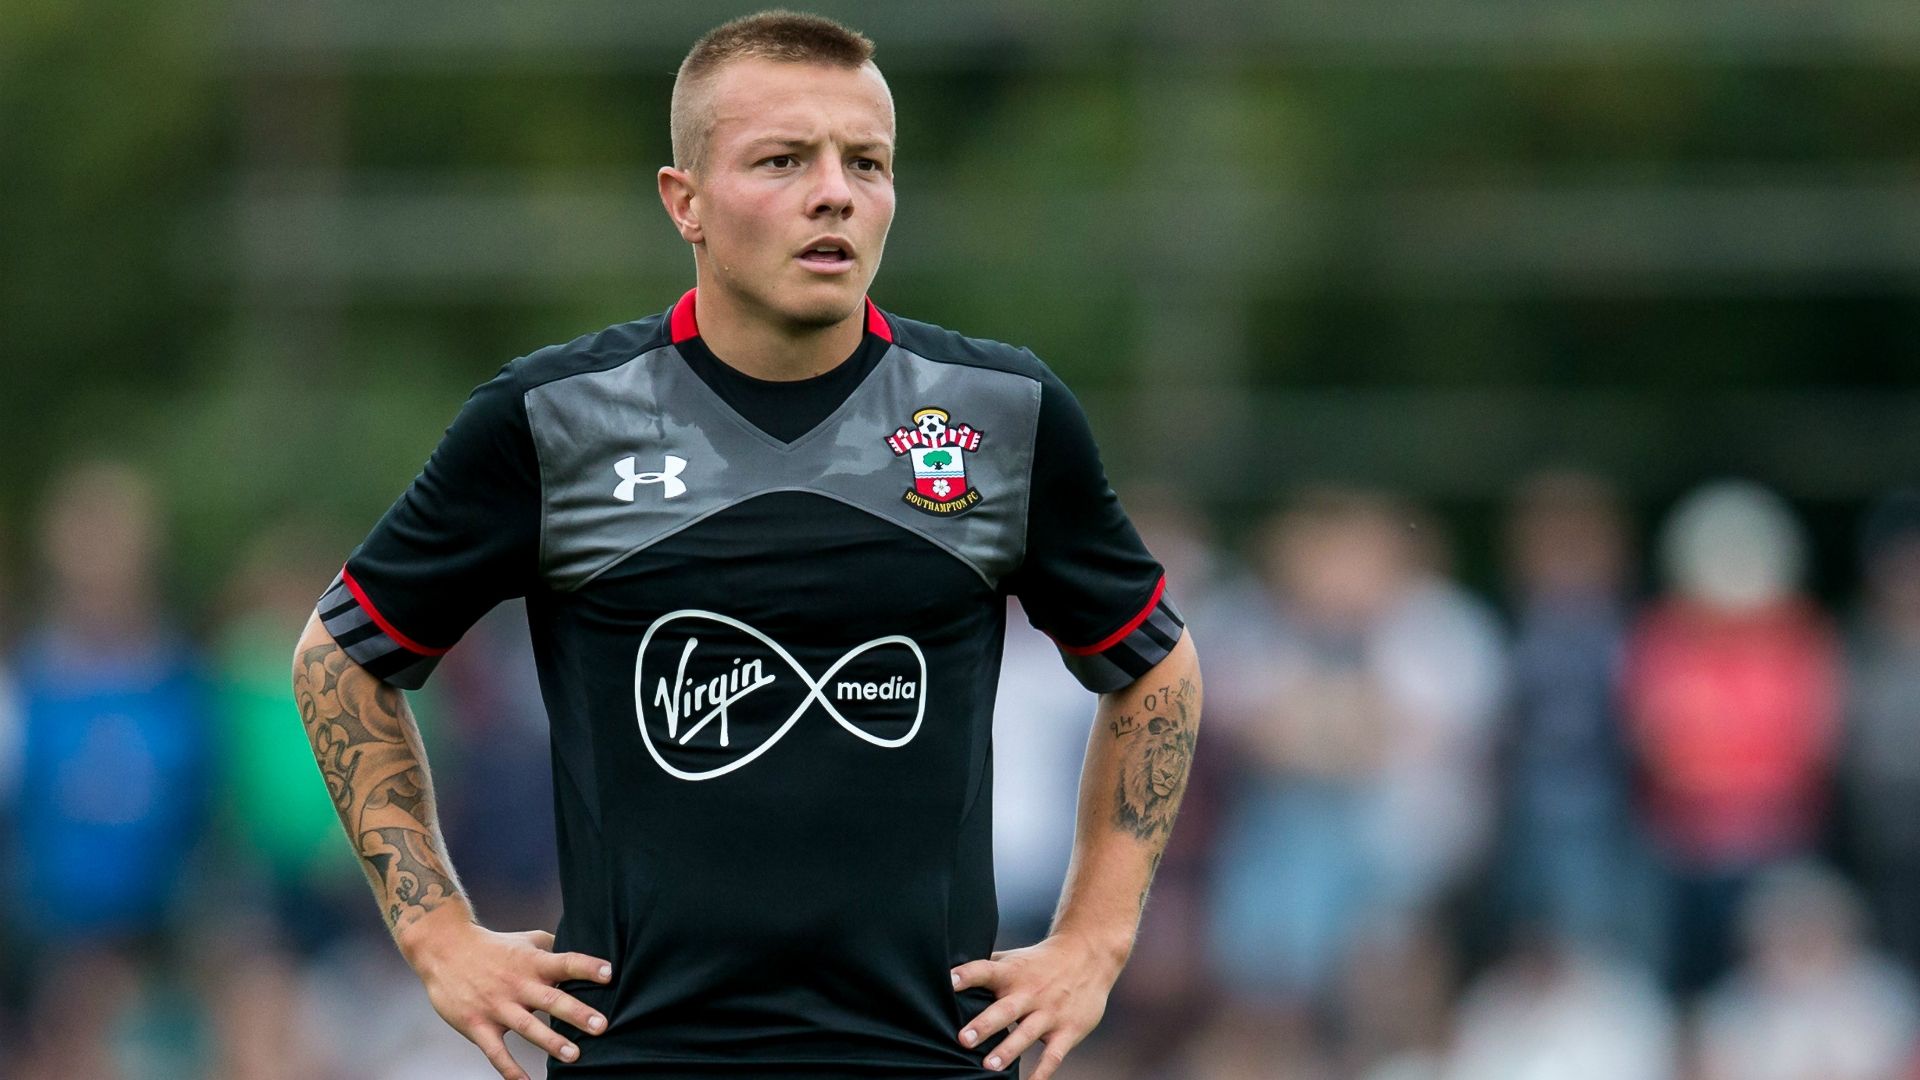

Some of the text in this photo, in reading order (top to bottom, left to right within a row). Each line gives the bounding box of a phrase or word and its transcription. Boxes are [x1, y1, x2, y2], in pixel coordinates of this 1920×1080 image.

[905, 490, 979, 512] SOUTHAMPTON FC
[654, 637, 917, 747] Virgin media
